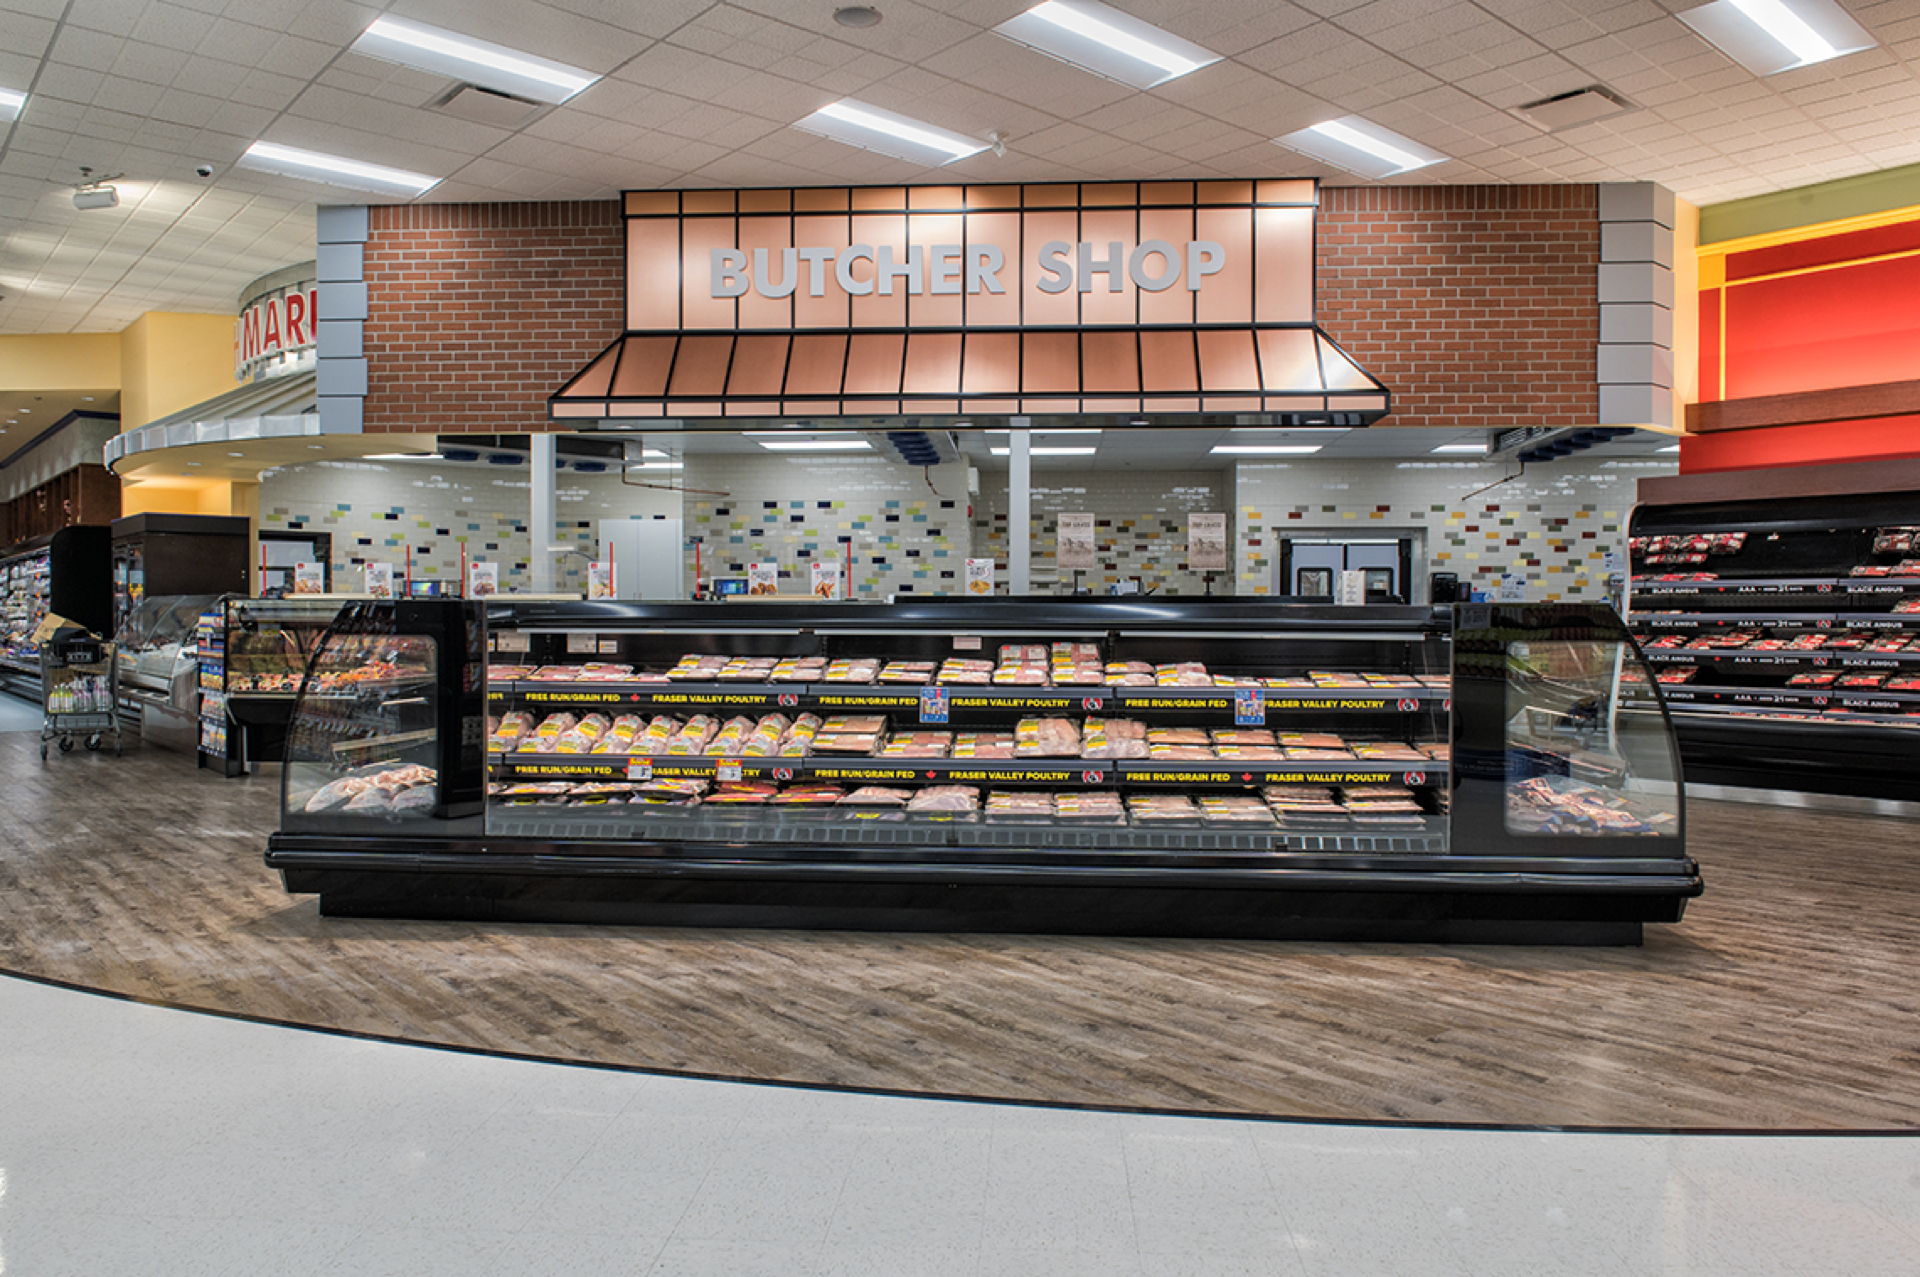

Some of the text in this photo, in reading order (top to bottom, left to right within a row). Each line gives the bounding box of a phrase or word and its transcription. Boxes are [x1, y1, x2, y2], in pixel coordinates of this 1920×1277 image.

[710, 240, 1225, 298] BUTCHER SHOP
[525, 692, 621, 702] FREE RUN/GRAIN FED
[652, 694, 767, 704] FRASER VALLEY POULTRY
[819, 696, 919, 706] FREE RUN/GRAIN FED
[950, 698, 1071, 708] FRASER VALLEY POULTRY
[1124, 698, 1228, 708] FREE RUN/GRAIN FED
[1301, 700, 1339, 709] VALLEY
[1340, 700, 1386, 709] POULTRY
[514, 765, 613, 775] FREE RUN/GRAIN FED
[651, 767, 681, 776] RASER
[681, 767, 718, 776] VALLEY
[814, 769, 916, 779] FREE RUN/GRAIN FED
[949, 770, 1071, 781] FRASER VALLEY POULTRY
[1126, 772, 1231, 782] FREE RUN/GRAIN FED
[1265, 773, 1392, 783] FRASER VALLEY POULTRY
